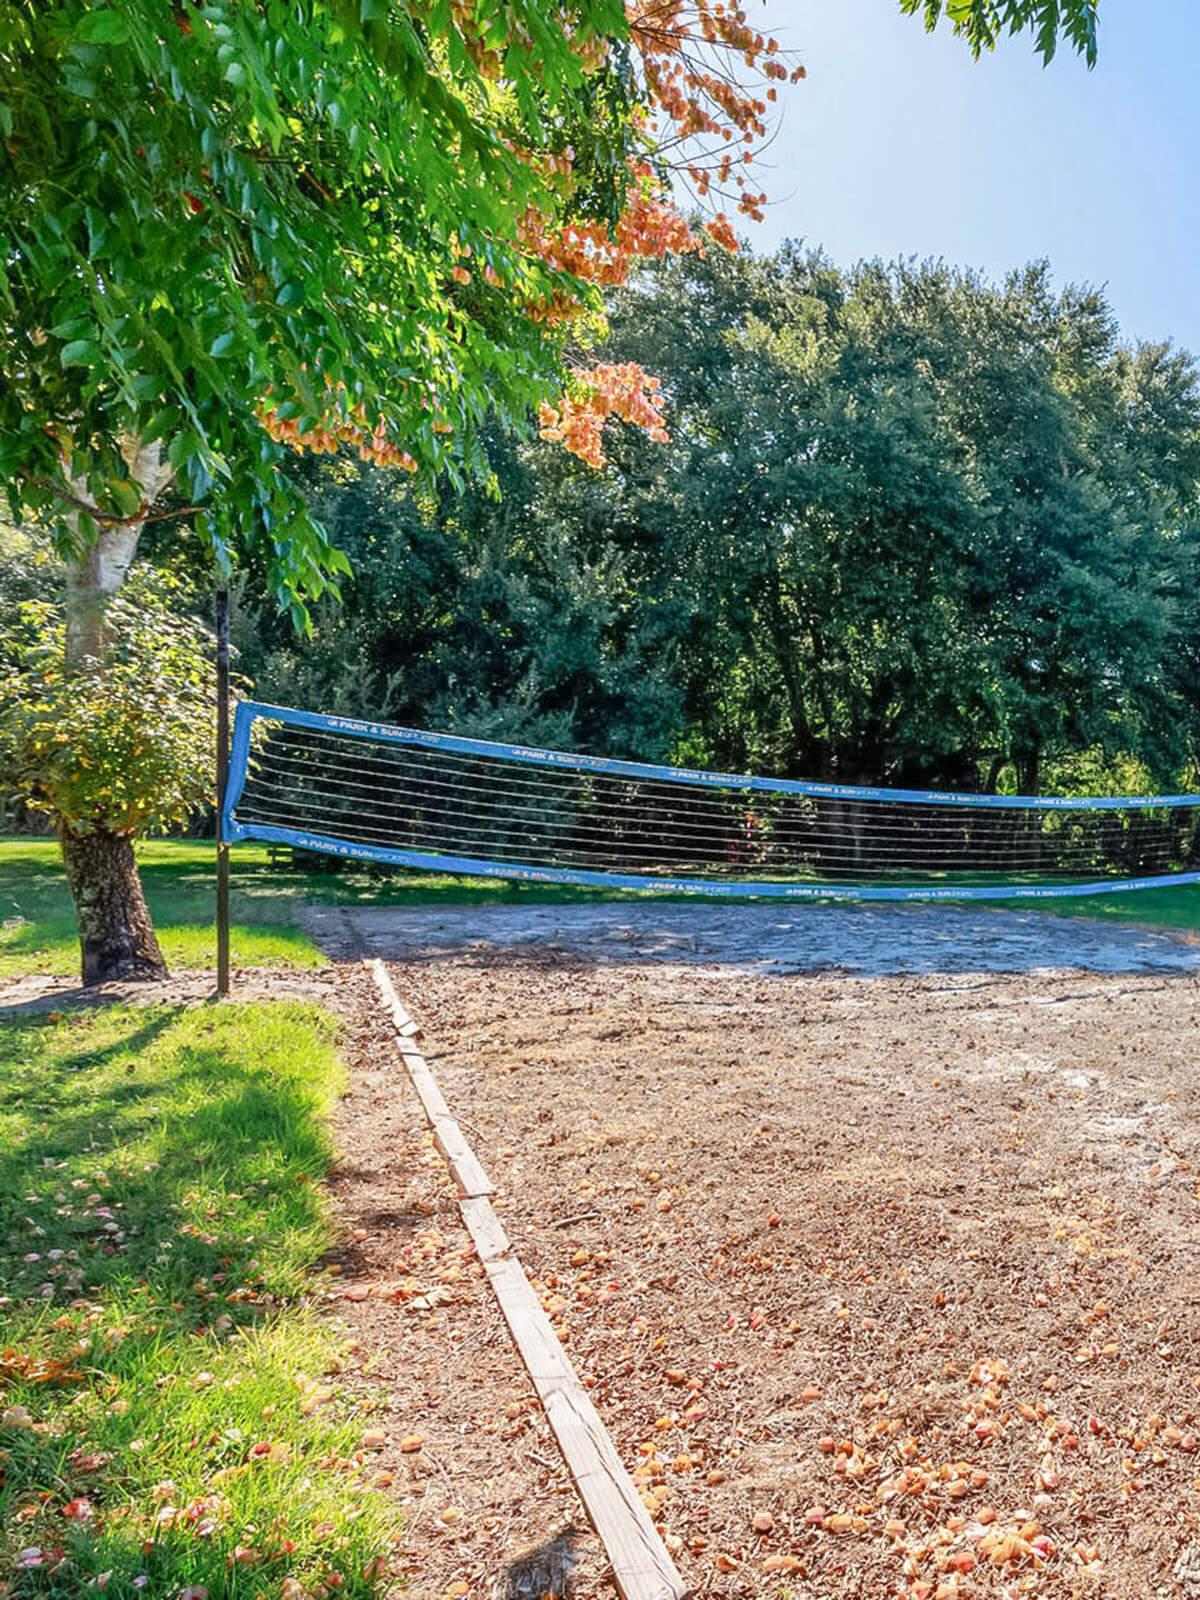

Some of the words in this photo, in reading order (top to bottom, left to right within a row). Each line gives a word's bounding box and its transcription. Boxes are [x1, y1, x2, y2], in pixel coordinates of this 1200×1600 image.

[339, 720, 368, 732] PARK
[380, 728, 401, 737] SUN
[522, 750, 546, 760] PARK
[310, 840, 337, 852] PARK
[350, 848, 372, 858] SUN
